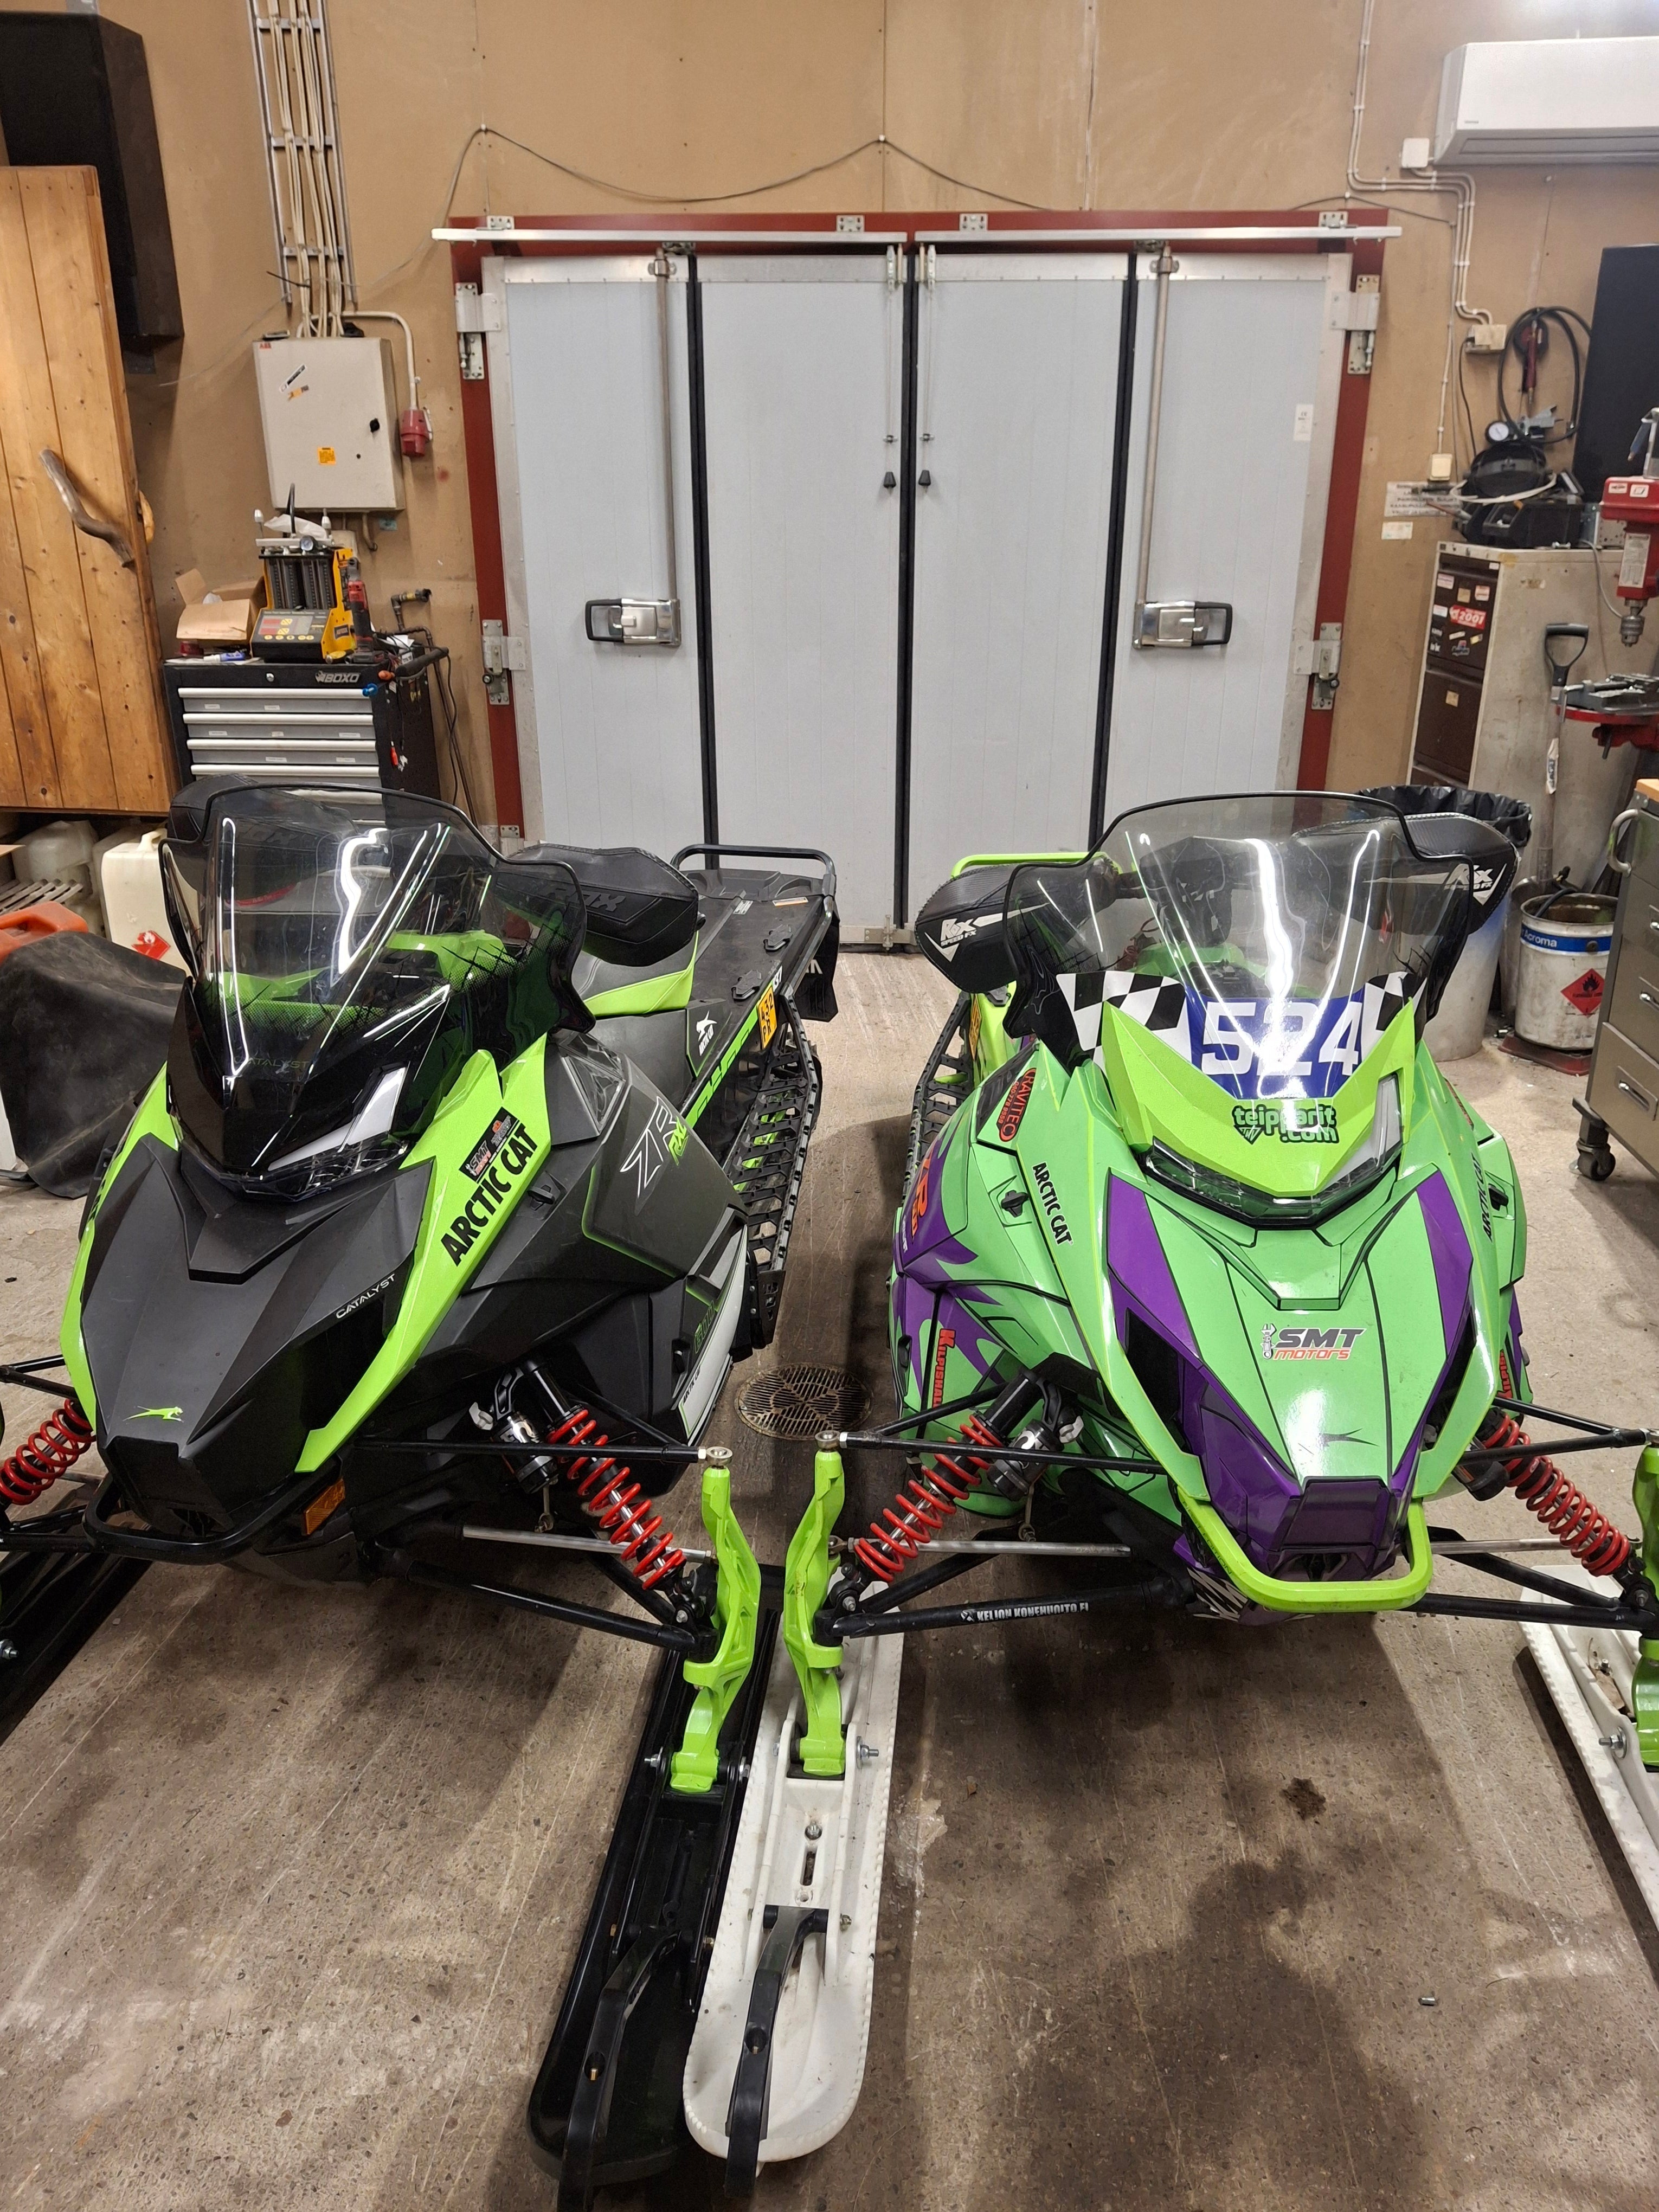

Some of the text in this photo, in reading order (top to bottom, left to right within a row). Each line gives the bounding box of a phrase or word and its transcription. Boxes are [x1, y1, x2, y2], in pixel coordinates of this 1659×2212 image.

[325, 673, 361, 683] BOXO
[1524, 929, 1557, 948] Acroma
[760, 993, 774, 1020] 432
[763, 1020, 772, 1044] PR
[1201, 1002, 1362, 1076] 524
[470, 1140, 488, 1167] SMT
[441, 1123, 538, 1267] ARCTIC CAT
[1032, 1162, 1072, 1245] ARCTIC CAT
[1477, 1180, 1493, 1243] ARCTIC
[336, 1273, 395, 1319] CATALYST
[1276, 1328, 1365, 1348] SMT
